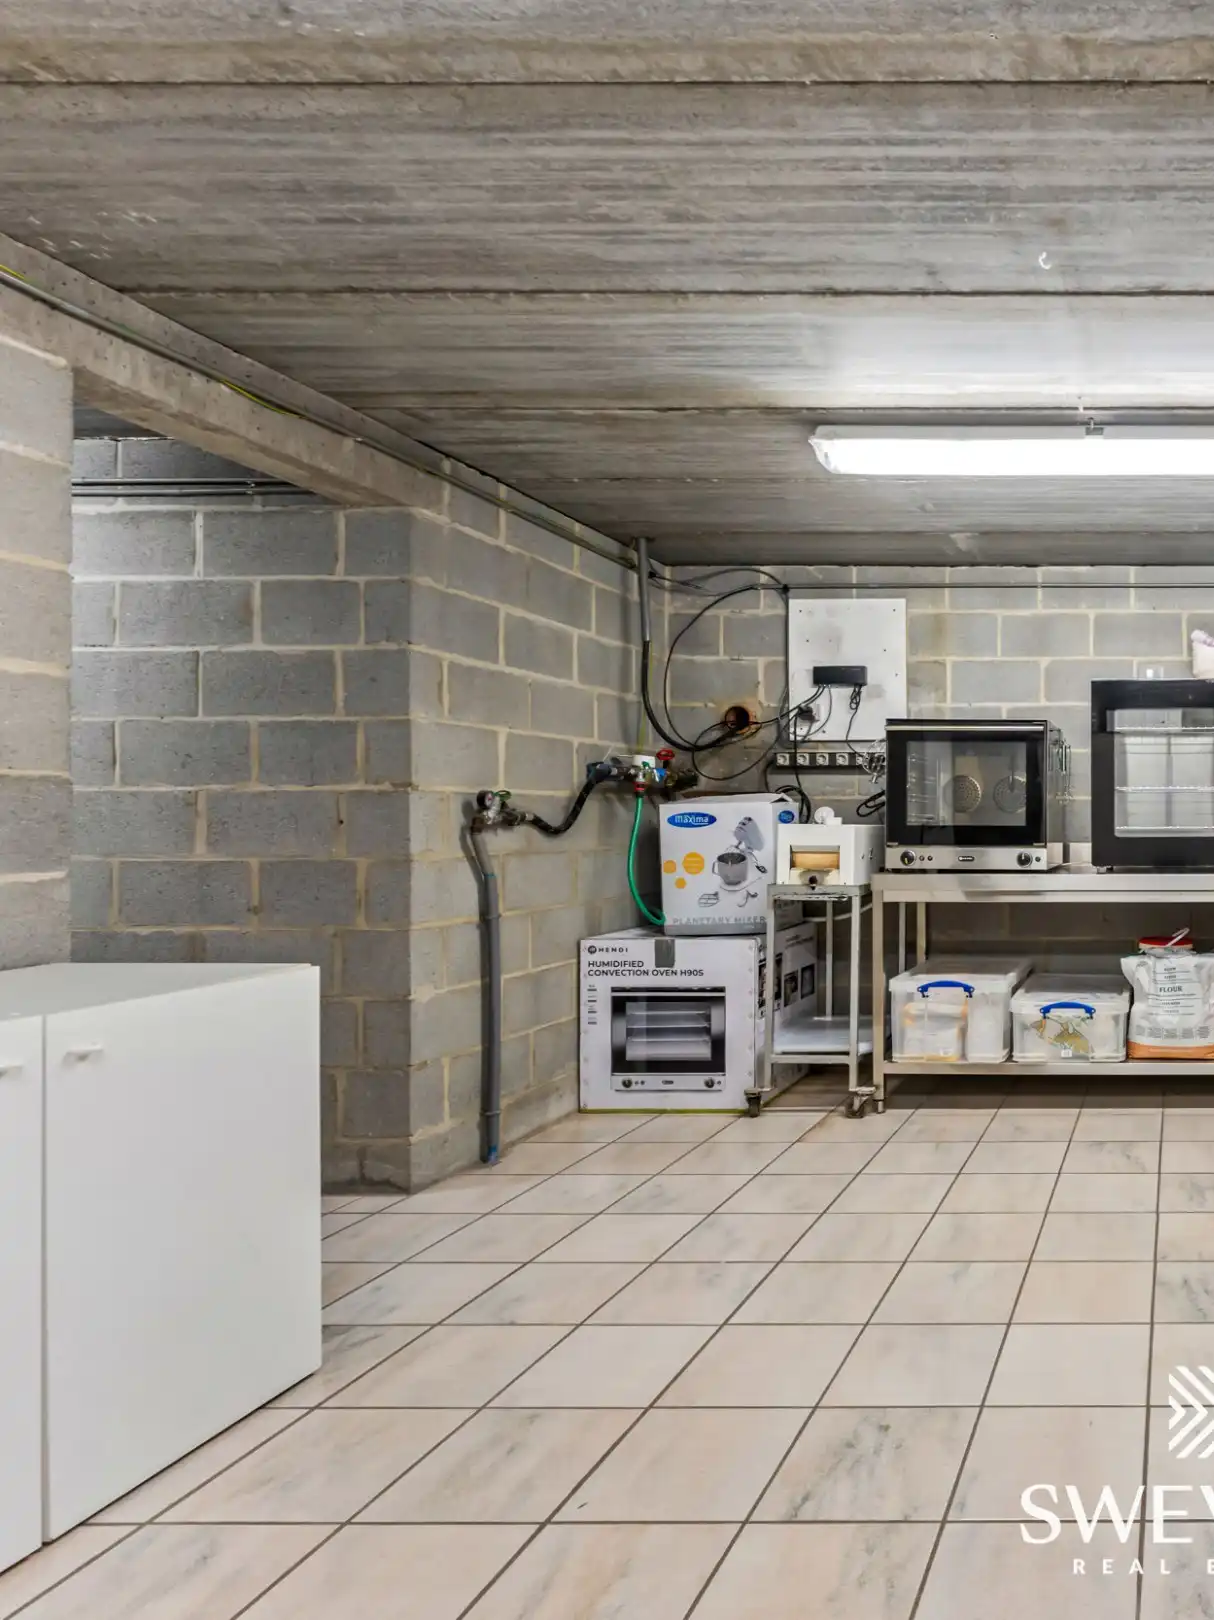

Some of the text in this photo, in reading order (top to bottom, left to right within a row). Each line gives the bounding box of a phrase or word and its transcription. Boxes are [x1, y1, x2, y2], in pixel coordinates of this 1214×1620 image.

[588, 960, 645, 968] HUMIDIFIED
[587, 969, 704, 977] CONVECTION OVEN H90S
[1159, 985, 1183, 993] FLOUR
